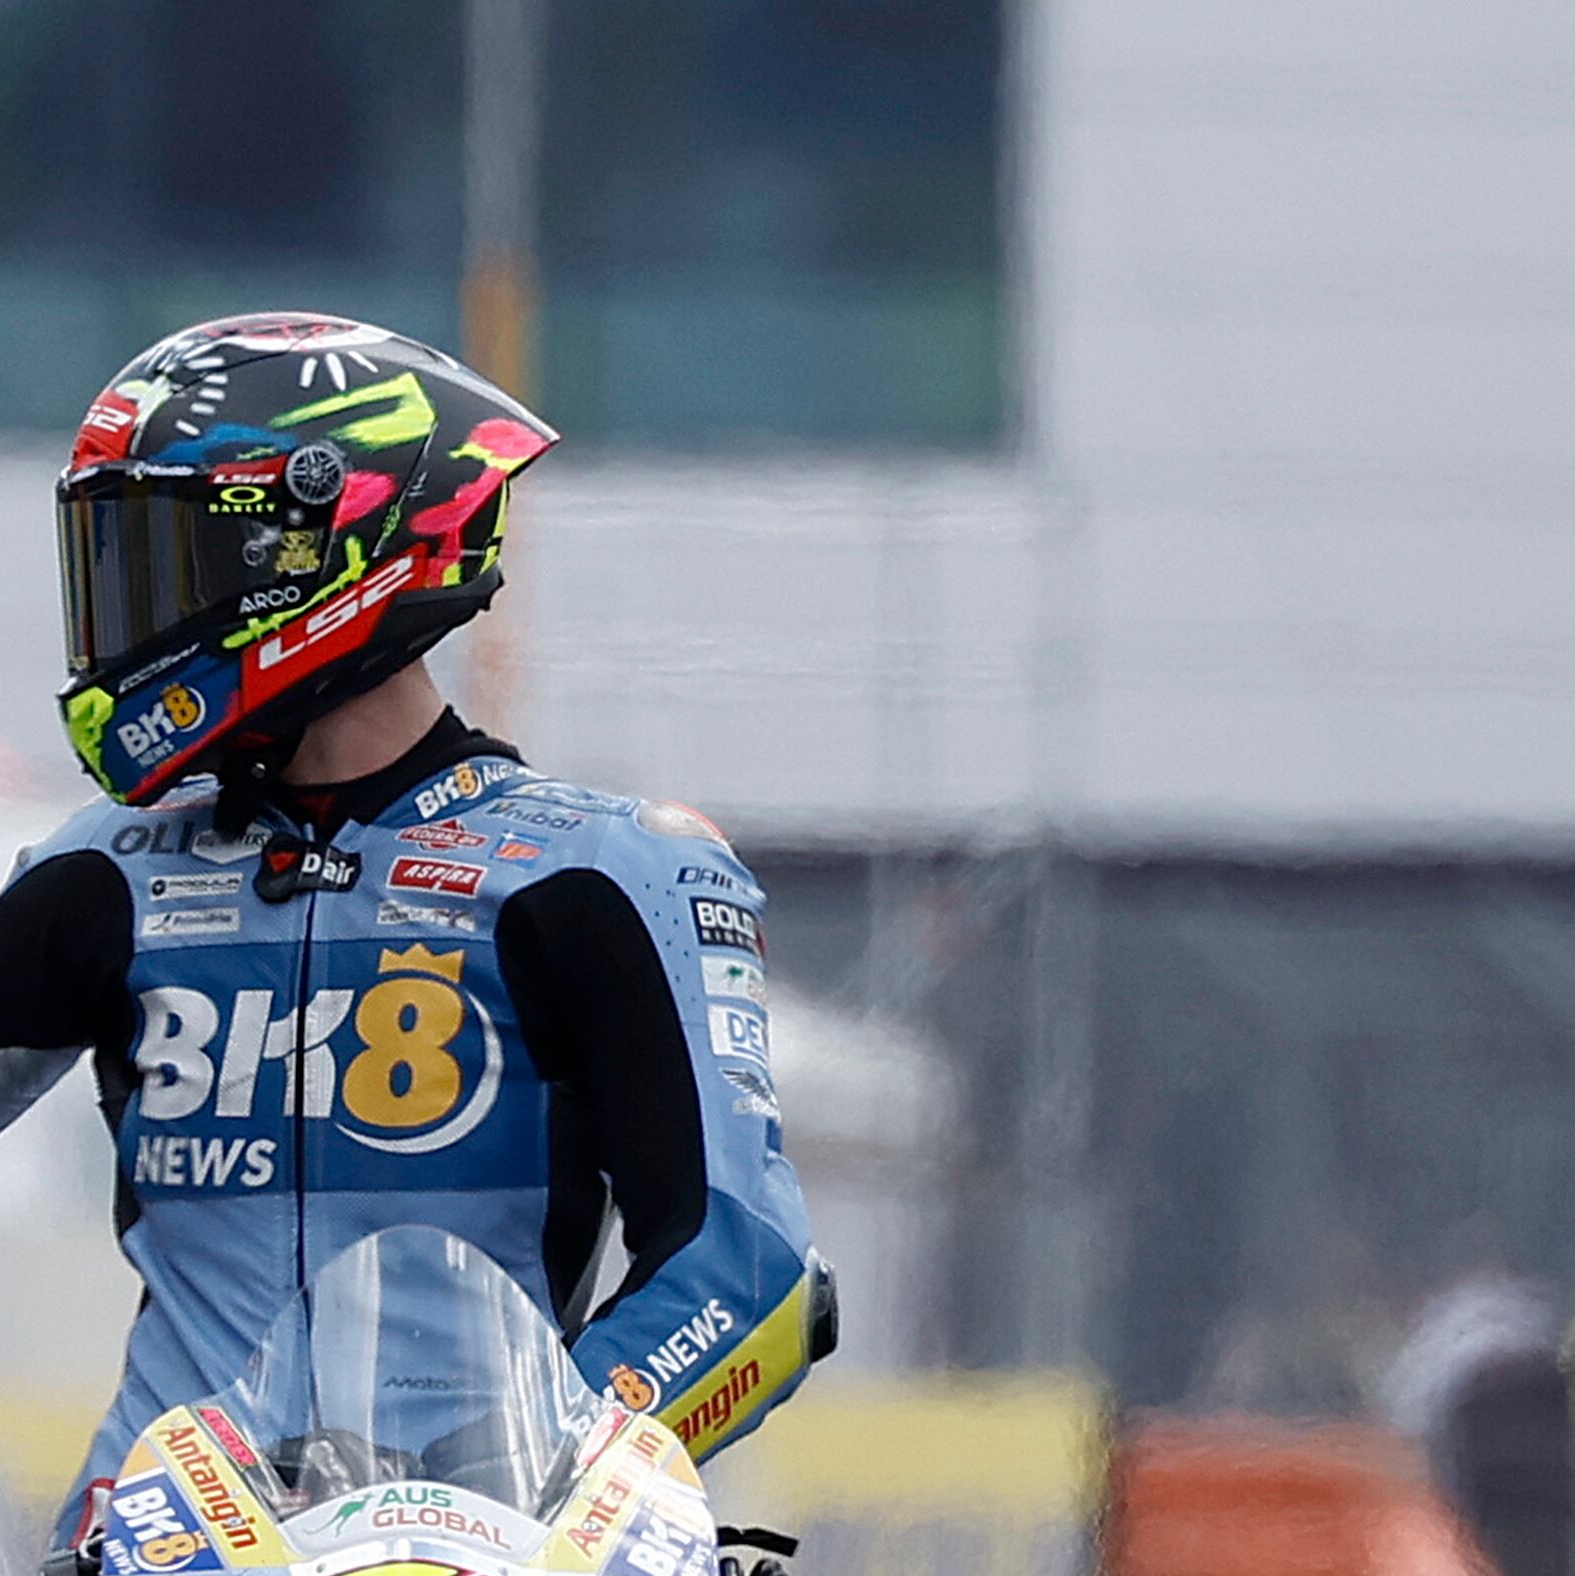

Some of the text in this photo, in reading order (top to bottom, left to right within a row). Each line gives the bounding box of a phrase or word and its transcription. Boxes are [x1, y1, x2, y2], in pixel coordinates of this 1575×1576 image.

[239, 585, 301, 614] ARCO
[259, 555, 414, 670] LS2
[116, 684, 199, 759] BK8
[414, 764, 479, 820] BK8
[485, 801, 584, 832] Unibat
[403, 863, 476, 884] ASPIRA
[138, 977, 465, 1128] BK8
[135, 1139, 277, 1188] NEWS
[646, 1299, 735, 1384] NEWS
[672, 1359, 761, 1446] angin
[157, 1426, 258, 1550] Antangin
[377, 1487, 454, 1508] AUS
[113, 1486, 200, 1565] BK8
[372, 1508, 512, 1551] GLOBAL
